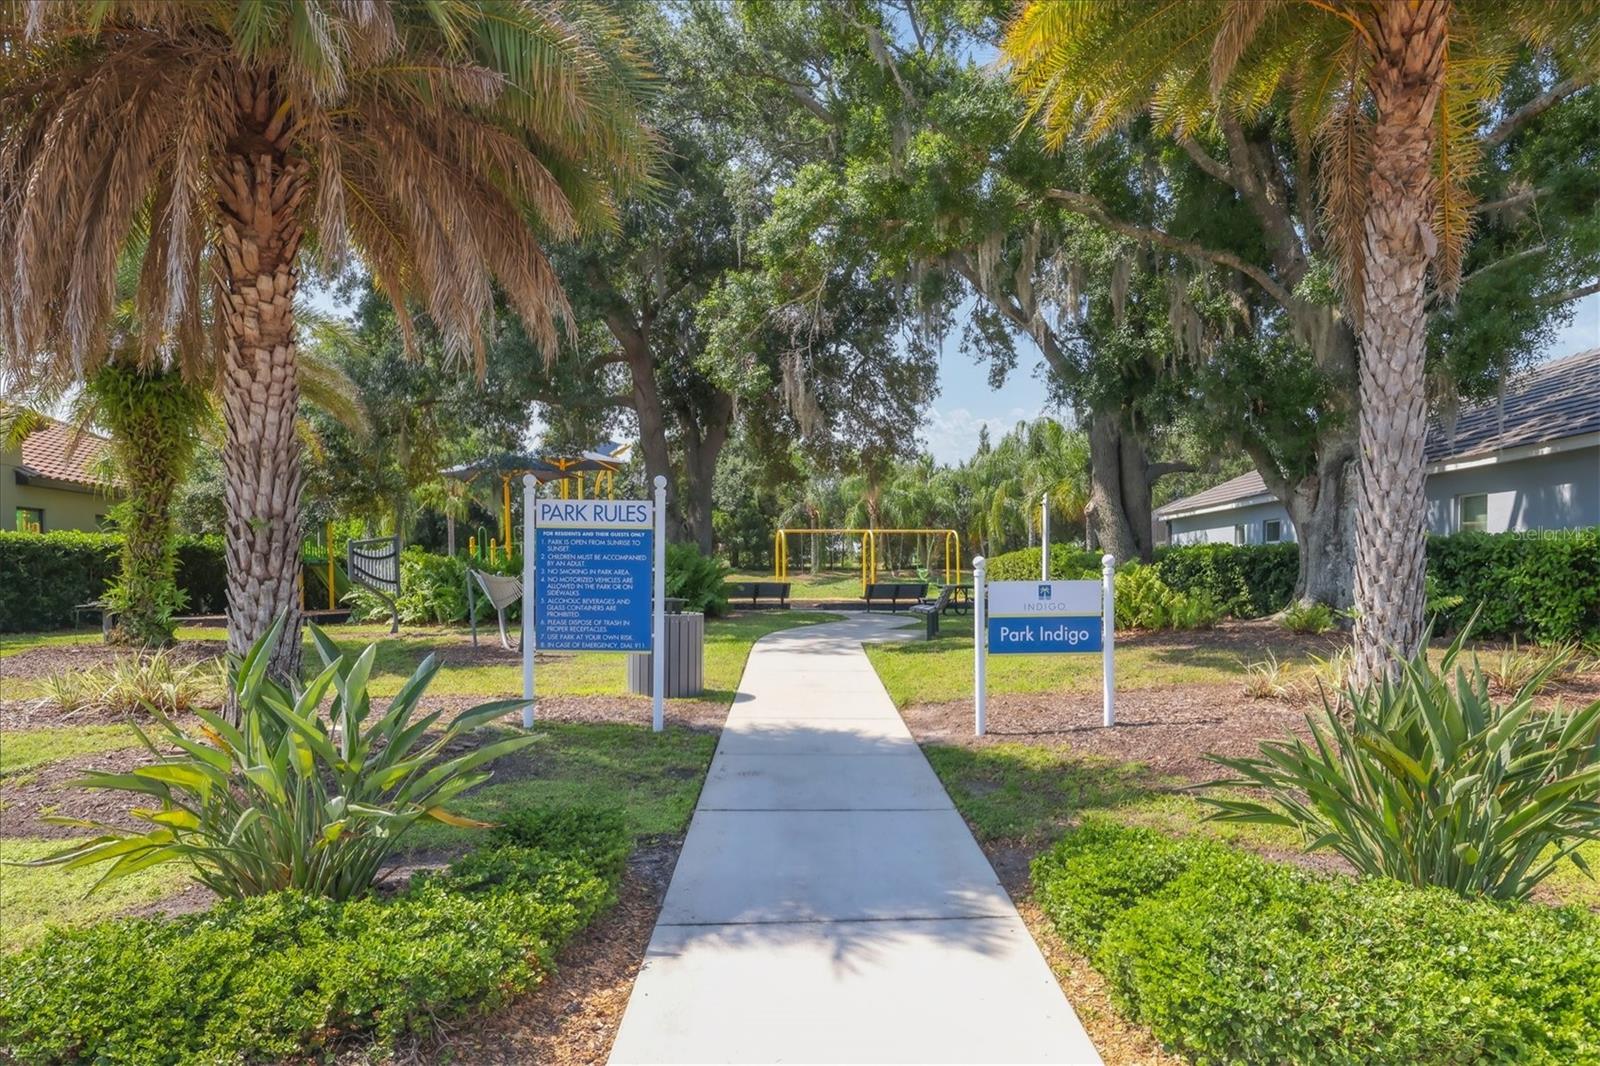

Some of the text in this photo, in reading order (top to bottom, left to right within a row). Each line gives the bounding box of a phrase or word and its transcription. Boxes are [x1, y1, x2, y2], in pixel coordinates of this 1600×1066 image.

[542, 504, 647, 522] PARK RULES
[1024, 603, 1066, 611] INDIGO
[1000, 625, 1089, 646] Park Indigo
